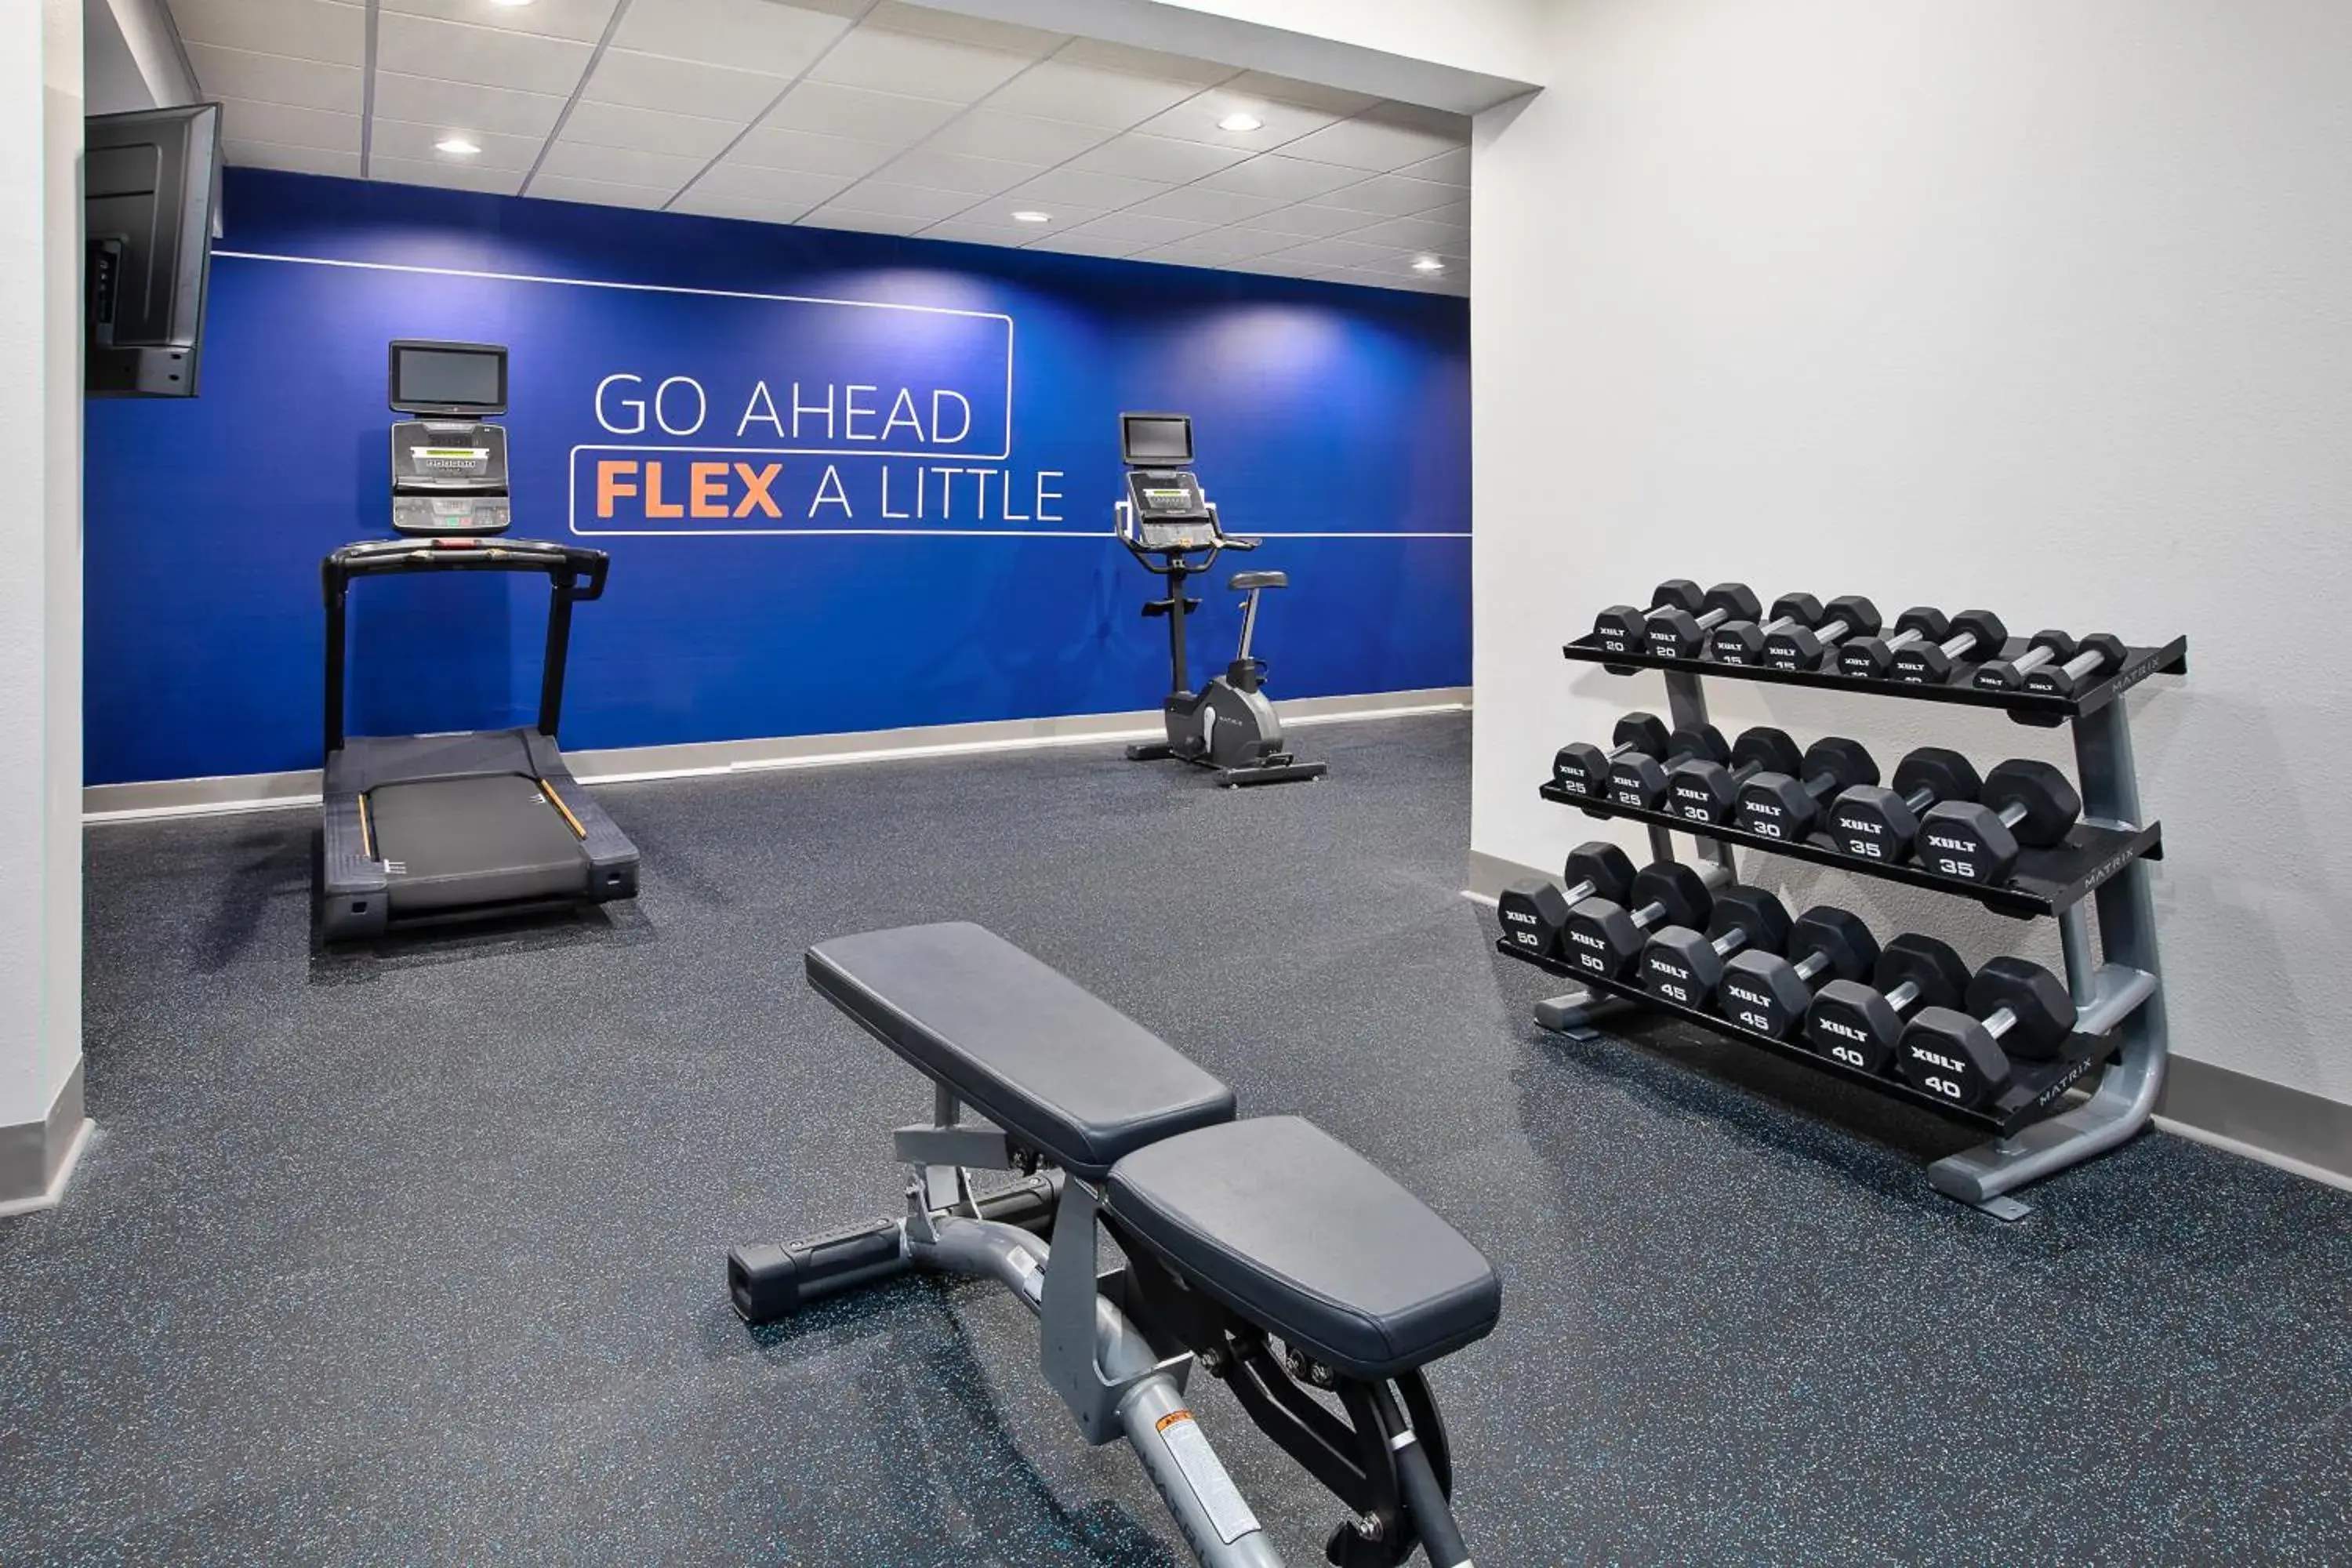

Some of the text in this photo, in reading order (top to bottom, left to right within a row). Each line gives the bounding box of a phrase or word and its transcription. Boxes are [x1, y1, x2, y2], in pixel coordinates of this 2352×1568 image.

[596, 374, 970, 442] GO AHEAD
[597, 461, 1063, 521] FLEX A LITTLE
[1605, 641, 1624, 652] 20
[1656, 645, 1676, 658] 20
[1559, 764, 1584, 777] XULT
[1565, 780, 1587, 794] 25
[1613, 775, 1640, 788] XULT
[1619, 791, 1642, 806] 25
[1676, 787, 1709, 801] XULT
[1685, 805, 1710, 822] 30
[1745, 800, 1782, 816] XULT
[1754, 820, 1782, 838] 30
[1839, 818, 1882, 834] XULT
[1849, 840, 1882, 858] 35
[1928, 835, 1976, 852] XULT
[1939, 858, 1975, 877] 35
[2085, 848, 2133, 888] MATRIX
[1505, 910, 1537, 924] XULT
[1516, 931, 1538, 946] 50
[1570, 931, 1605, 950] XULT
[1581, 953, 1604, 971] 50
[1650, 959, 1689, 979] XULT
[1661, 983, 1688, 1002] 45
[1729, 985, 1771, 1007] XULT
[1739, 1011, 1770, 1032] 45
[1820, 1018, 1867, 1042] XULT
[1832, 1045, 1866, 1069] 40
[1911, 1045, 1965, 1073] XULT
[1925, 1076, 1961, 1099] 40
[2040, 1056, 2091, 1107] MATRIX
